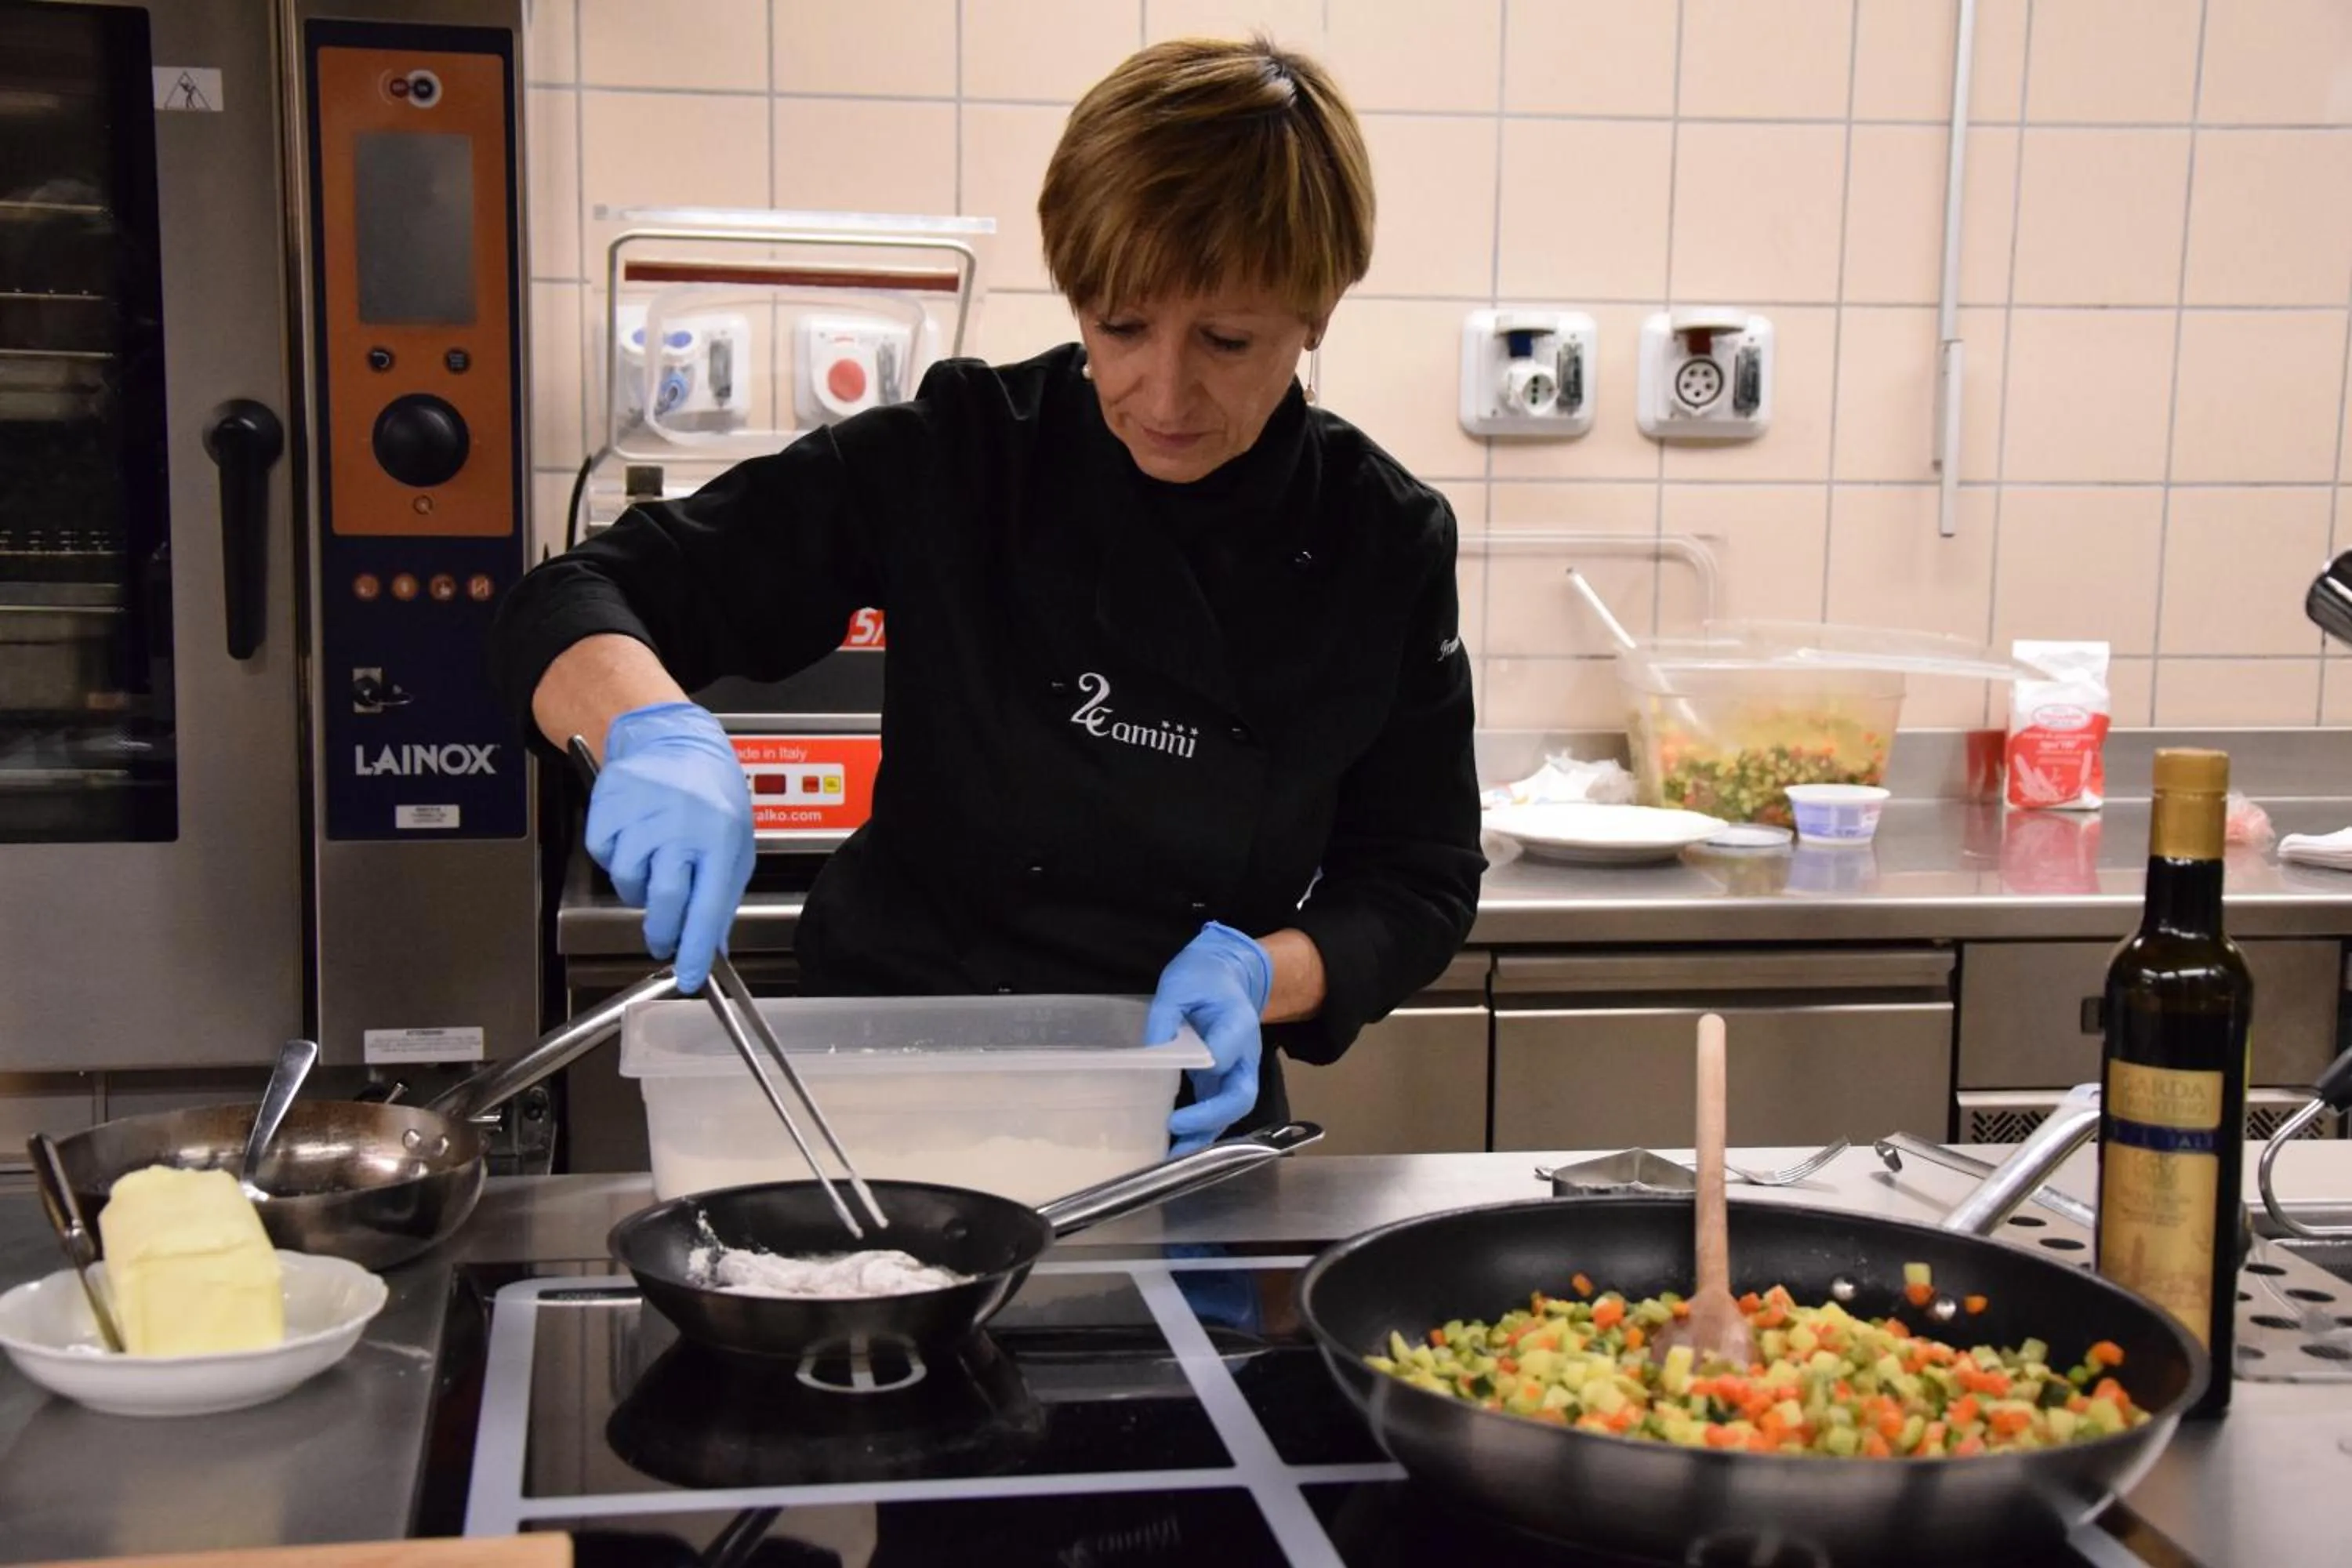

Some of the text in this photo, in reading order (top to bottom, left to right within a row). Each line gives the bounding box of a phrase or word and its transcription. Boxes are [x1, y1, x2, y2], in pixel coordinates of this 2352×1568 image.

[355, 743, 497, 776] LAINOX
[739, 745, 808, 763] ade in Italy
[754, 808, 822, 822] alko.com
